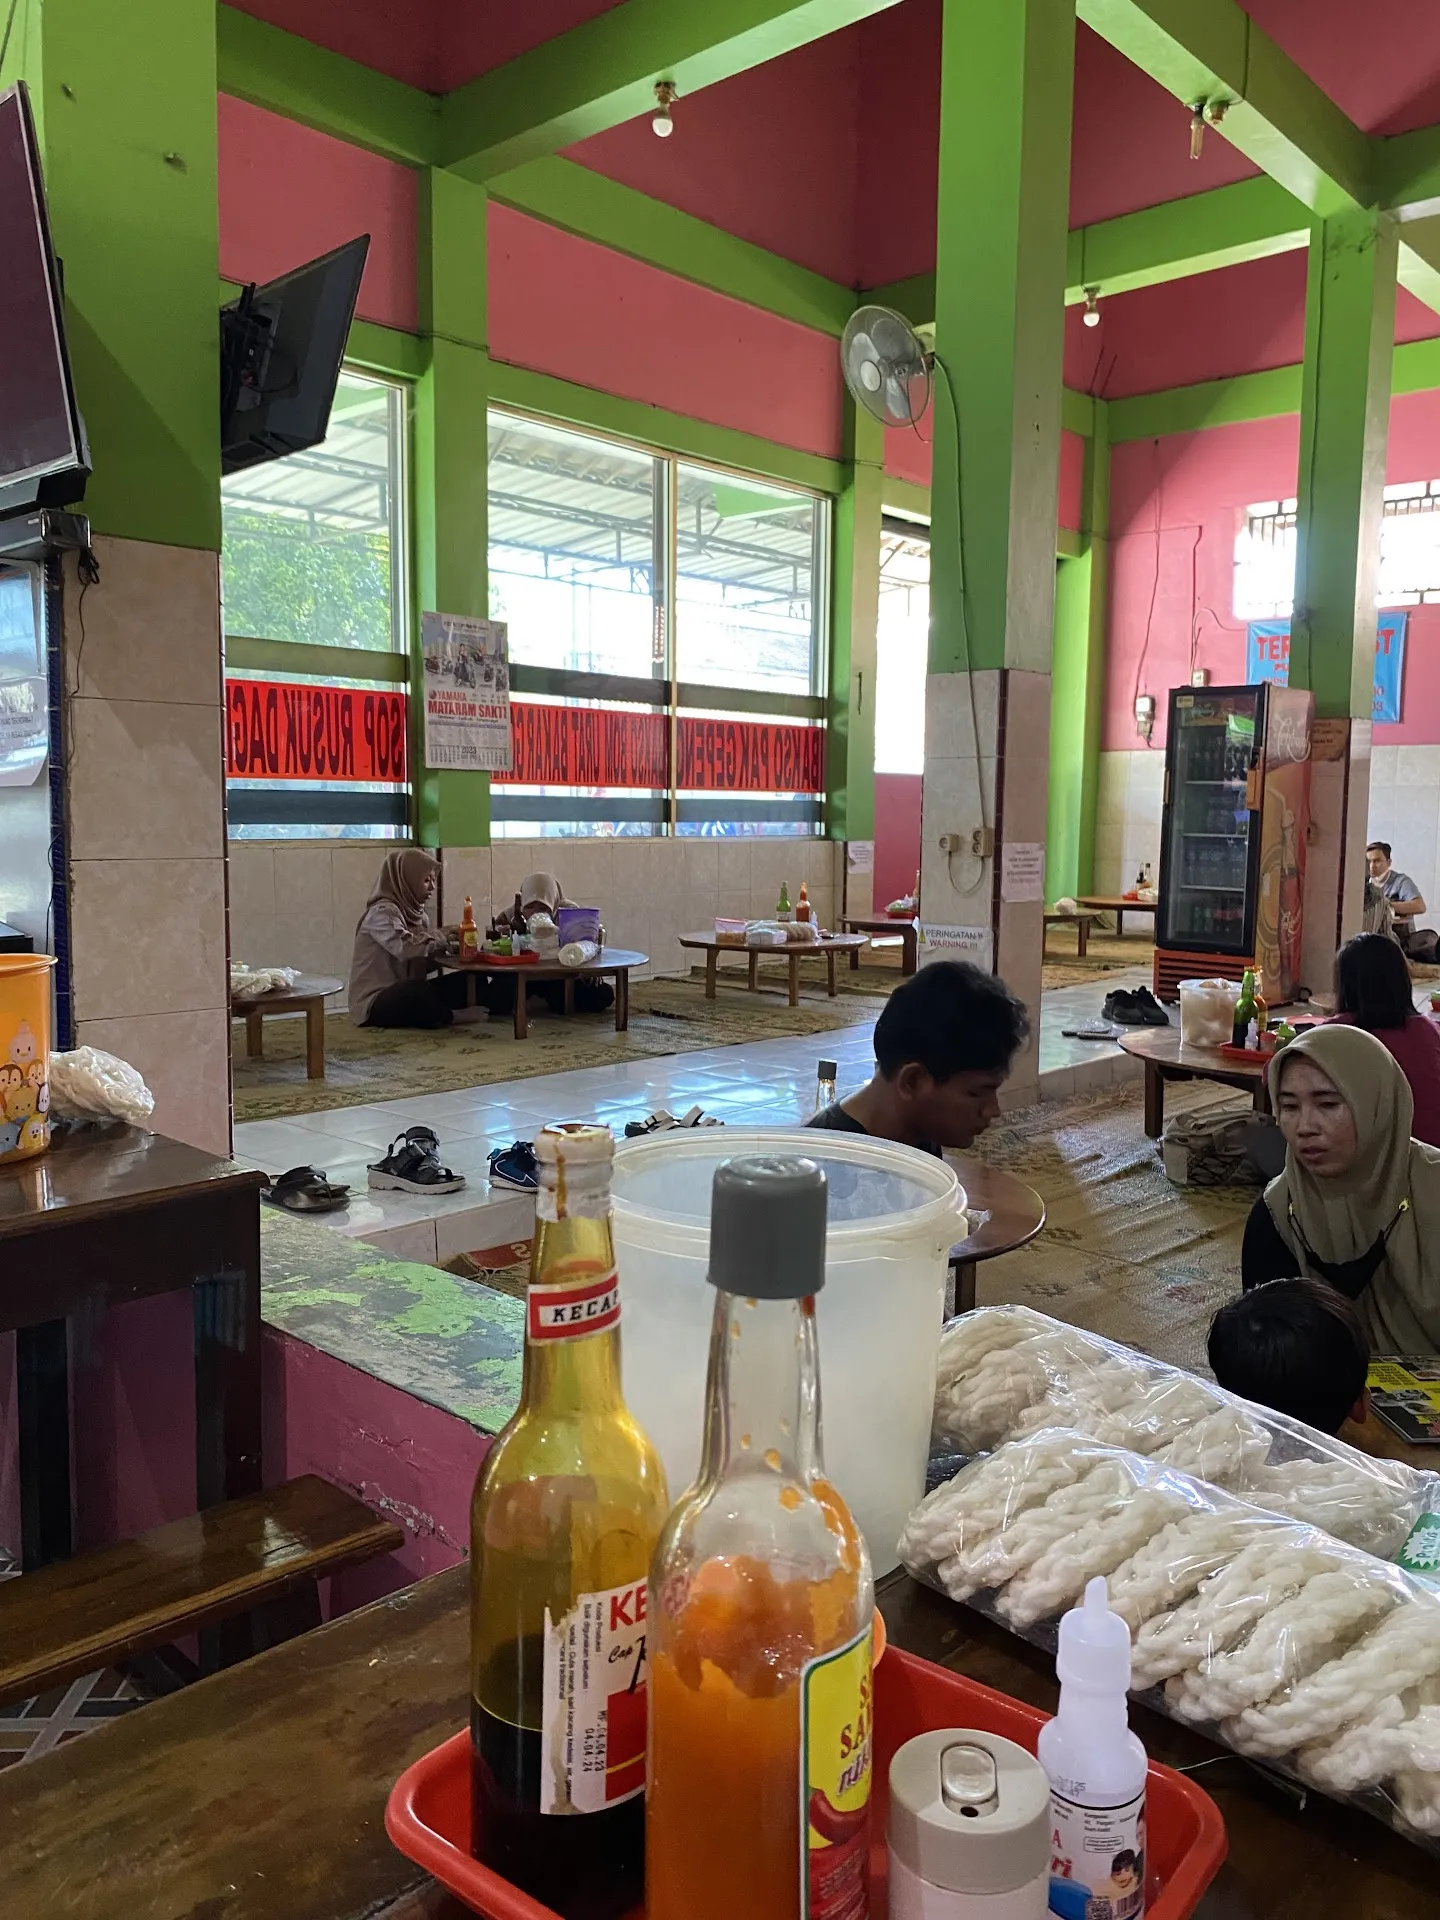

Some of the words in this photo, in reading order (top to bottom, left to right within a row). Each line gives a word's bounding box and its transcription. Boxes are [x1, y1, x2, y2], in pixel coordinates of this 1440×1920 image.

[437, 690, 467, 701] YAMAHA
[428, 700, 477, 717] MATARAM
[478, 704, 507, 719] SAKTI
[930, 940, 967, 949] WARNING
